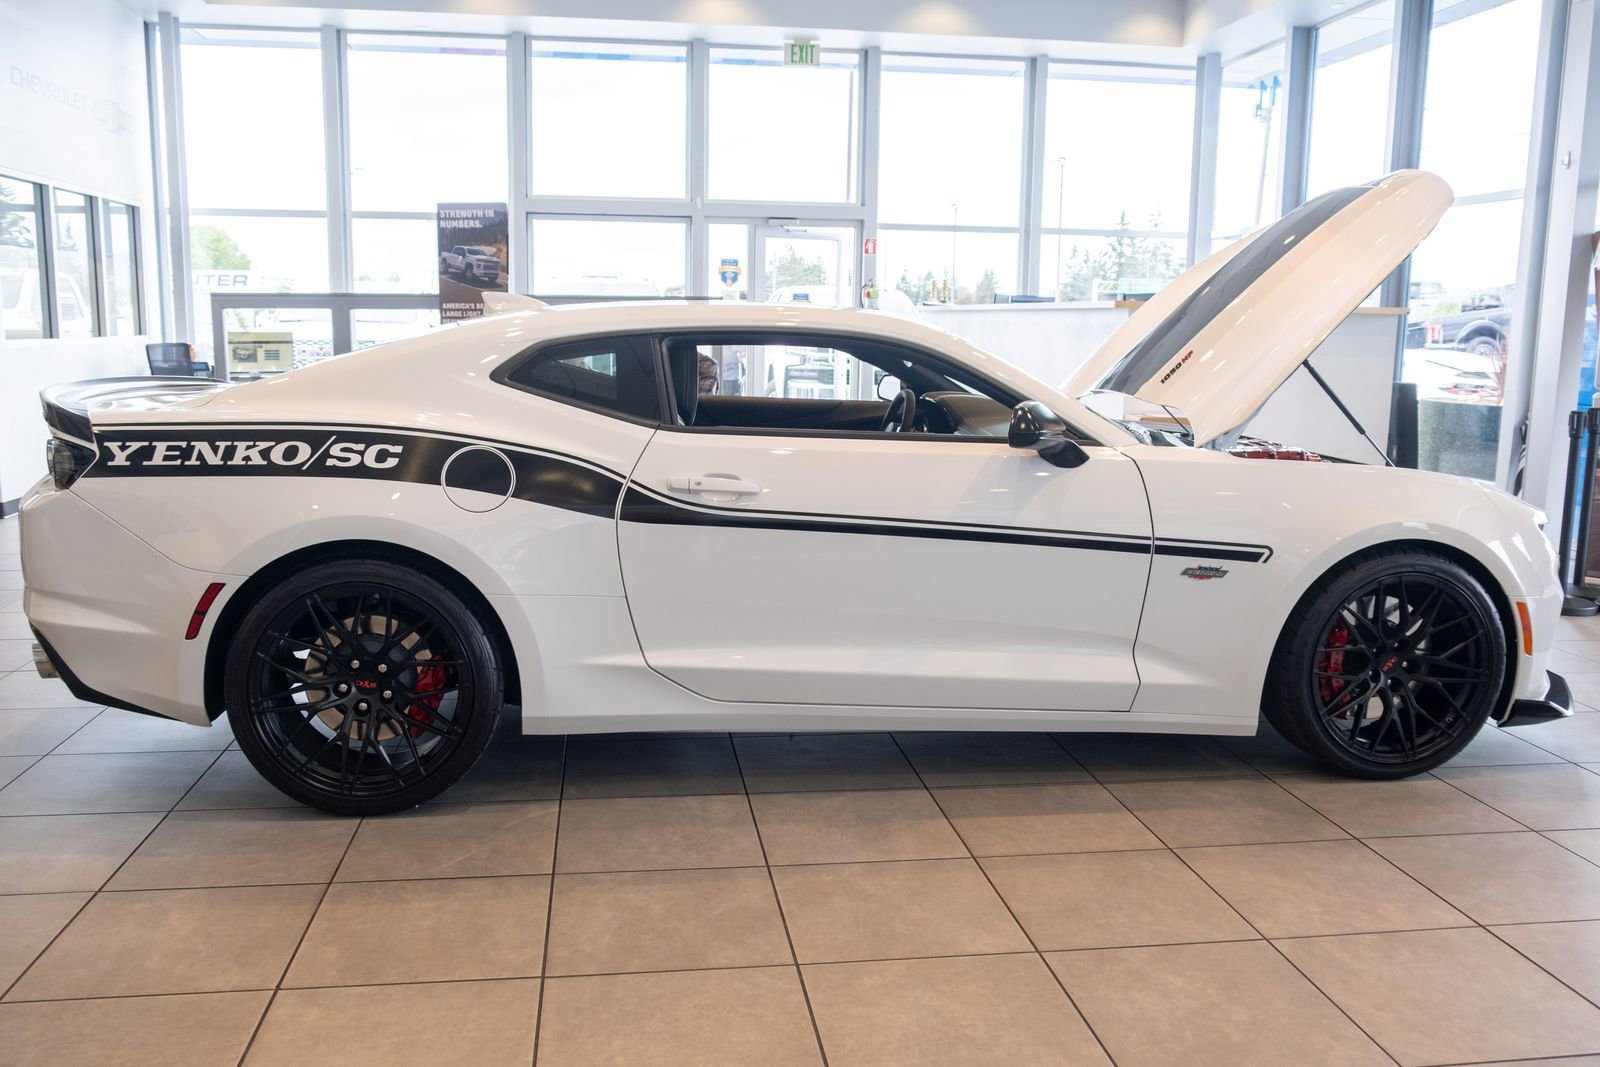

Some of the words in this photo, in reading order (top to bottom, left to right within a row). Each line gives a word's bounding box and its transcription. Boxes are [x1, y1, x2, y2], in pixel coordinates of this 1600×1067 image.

[791, 44, 816, 64] EXIT
[9, 64, 88, 112] CHEVROLET
[440, 209, 483, 218] STRENGTH
[485, 209, 495, 218] IN
[440, 219, 483, 228] NUMBERS.
[1160, 361, 1183, 384] 1050
[103, 435, 403, 470] YENKO/SC
